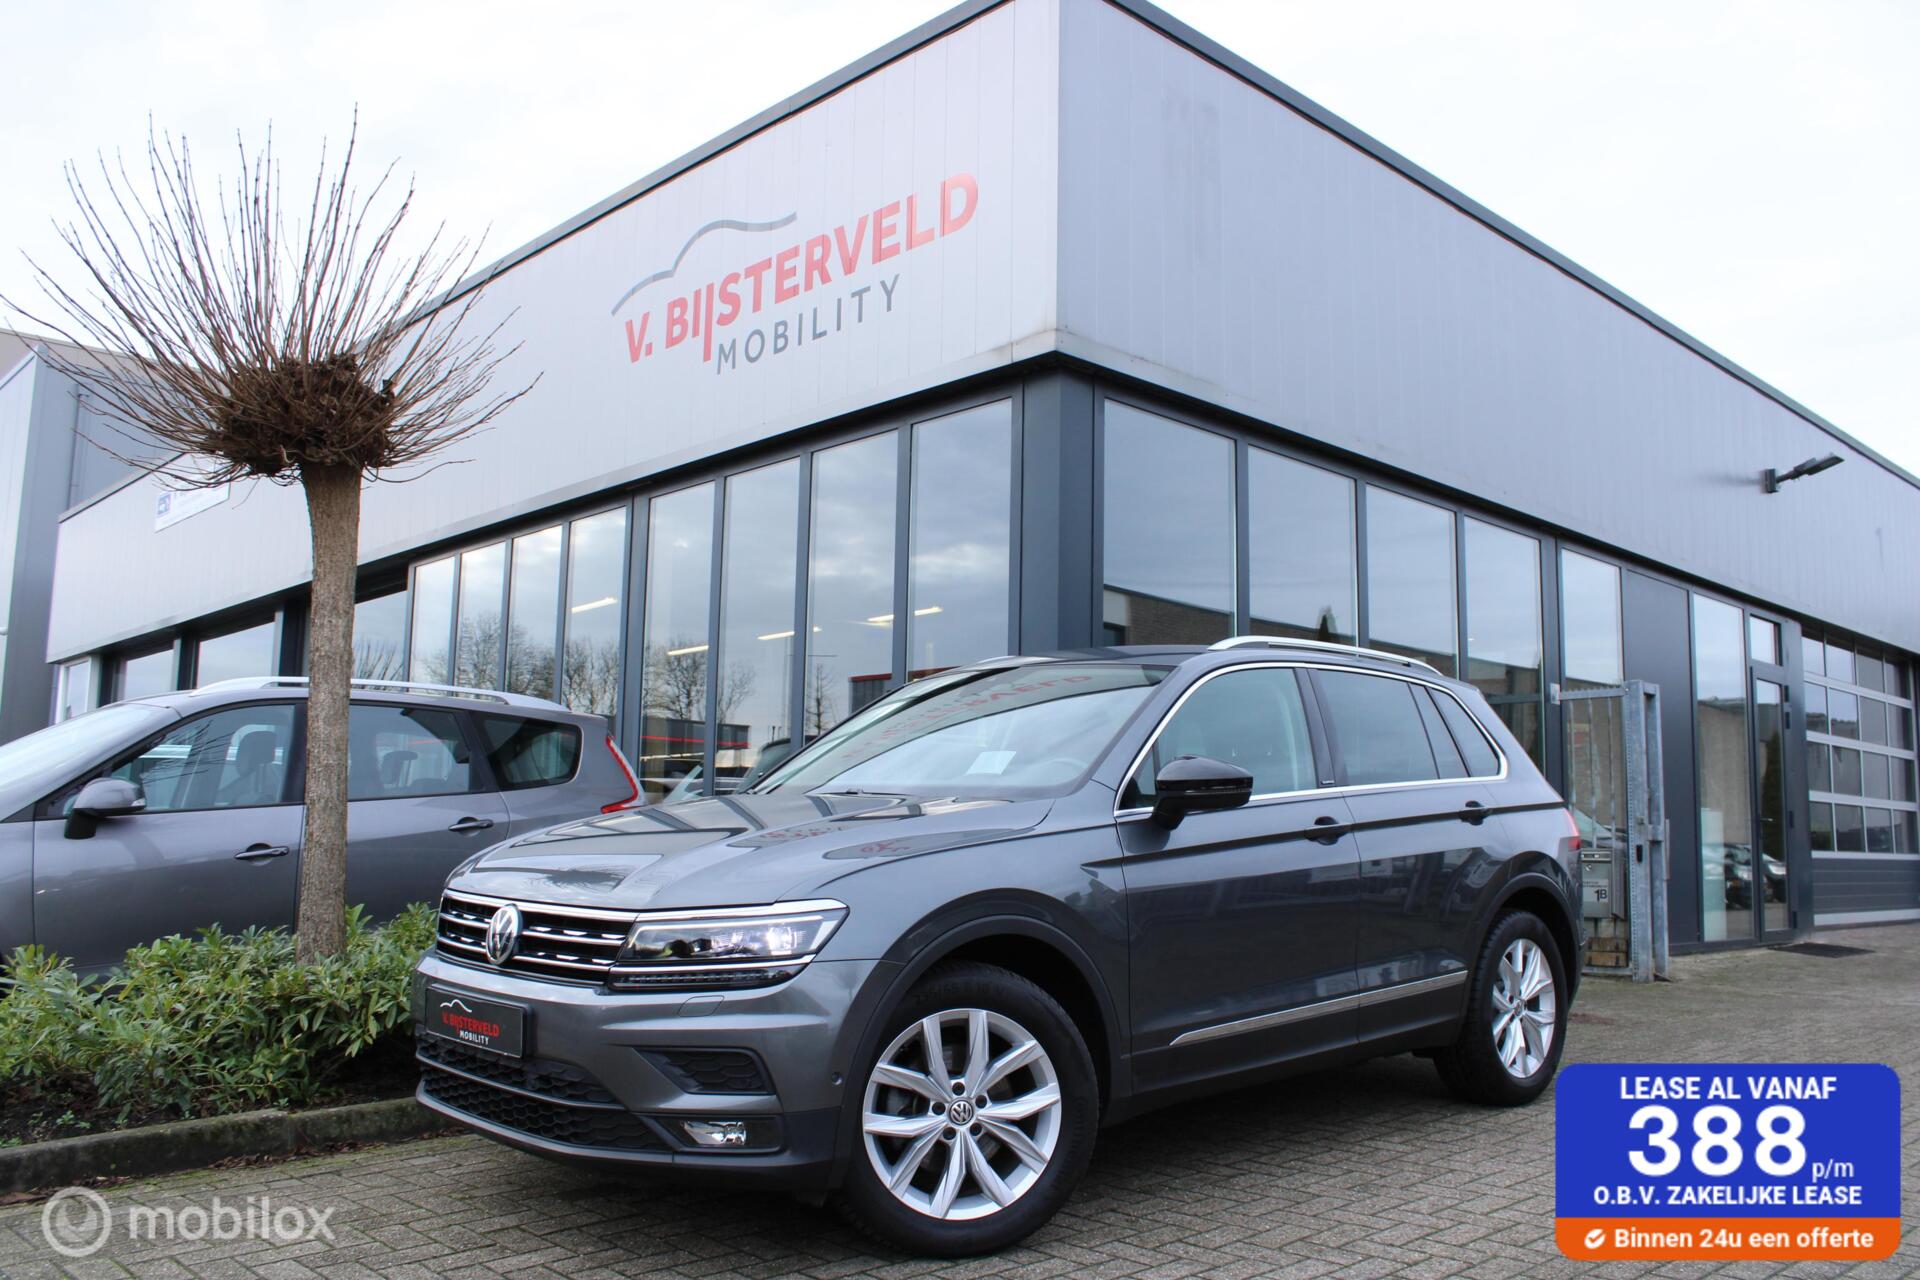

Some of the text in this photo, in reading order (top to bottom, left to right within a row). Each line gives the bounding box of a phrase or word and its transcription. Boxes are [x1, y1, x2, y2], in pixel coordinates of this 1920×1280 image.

[625, 311, 653, 363] V.
[716, 274, 900, 375] MOBILITY
[1594, 889, 1608, 902] 1B
[459, 1030, 489, 1045] MOBILITY
